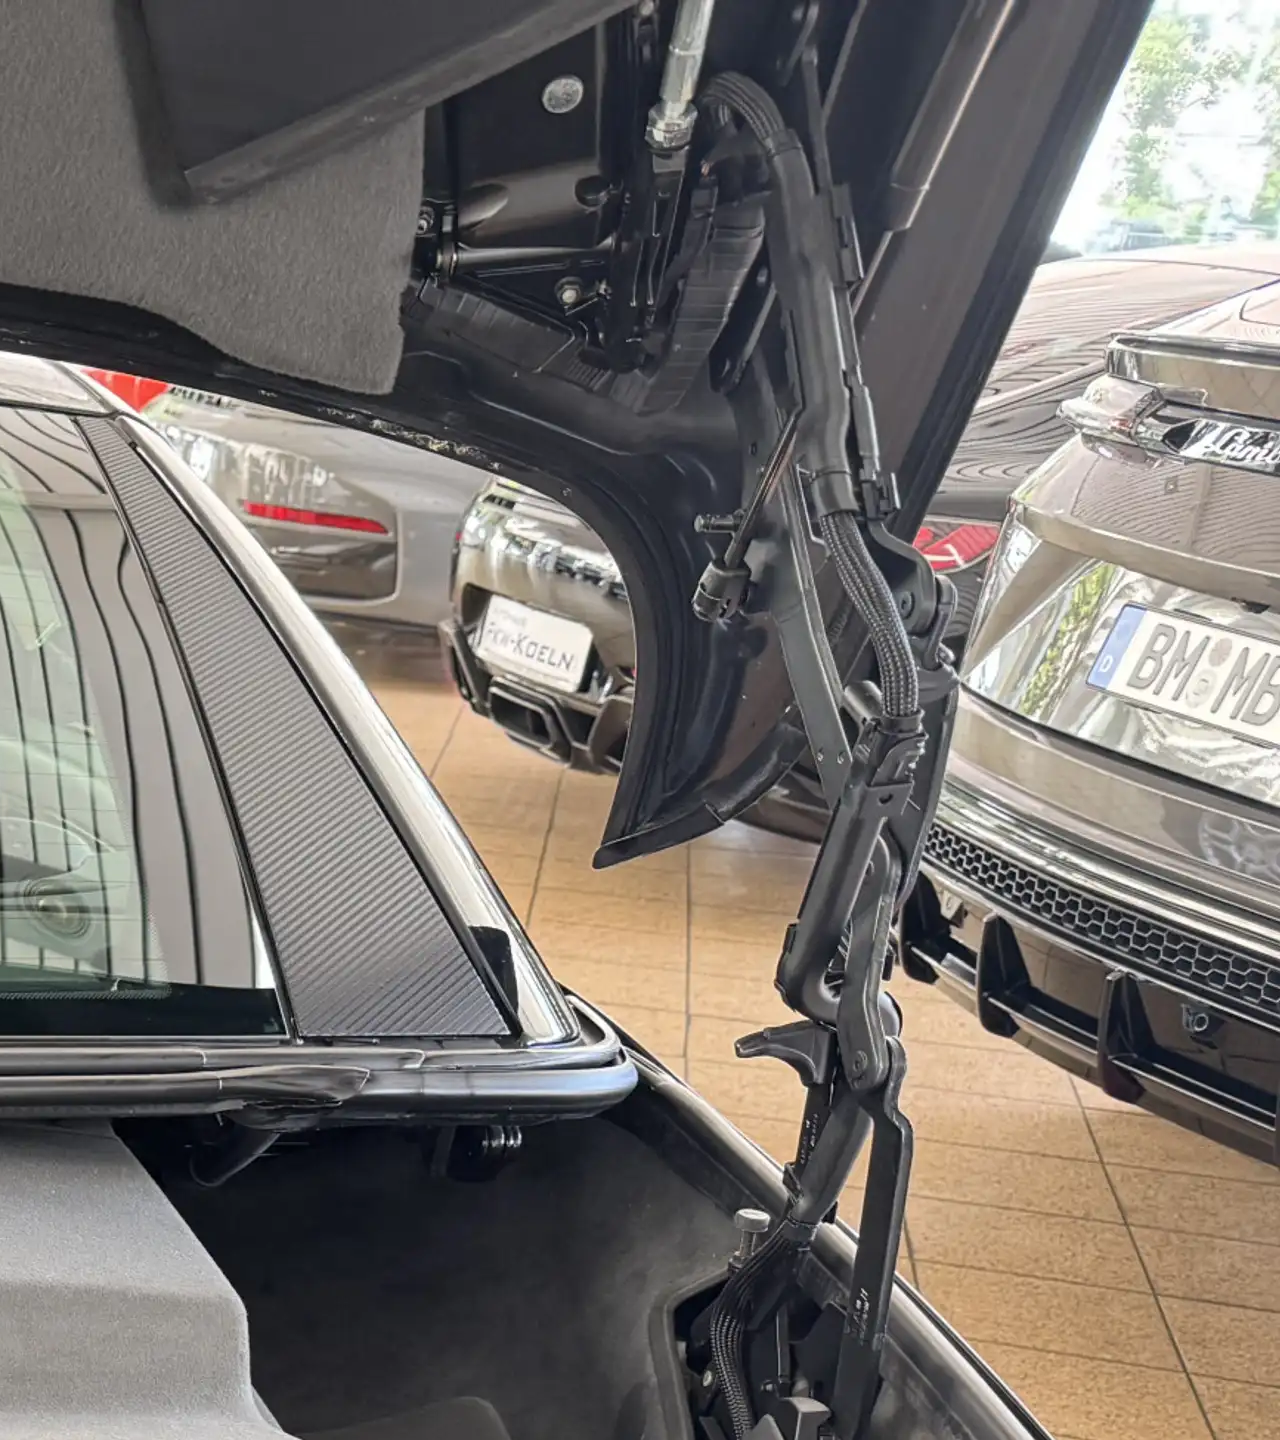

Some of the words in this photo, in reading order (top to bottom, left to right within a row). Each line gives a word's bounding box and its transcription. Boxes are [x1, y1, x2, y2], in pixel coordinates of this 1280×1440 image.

[1098, 655, 1113, 673] D
[1126, 622, 1212, 702] BM
[1210, 646, 1280, 726] MB
